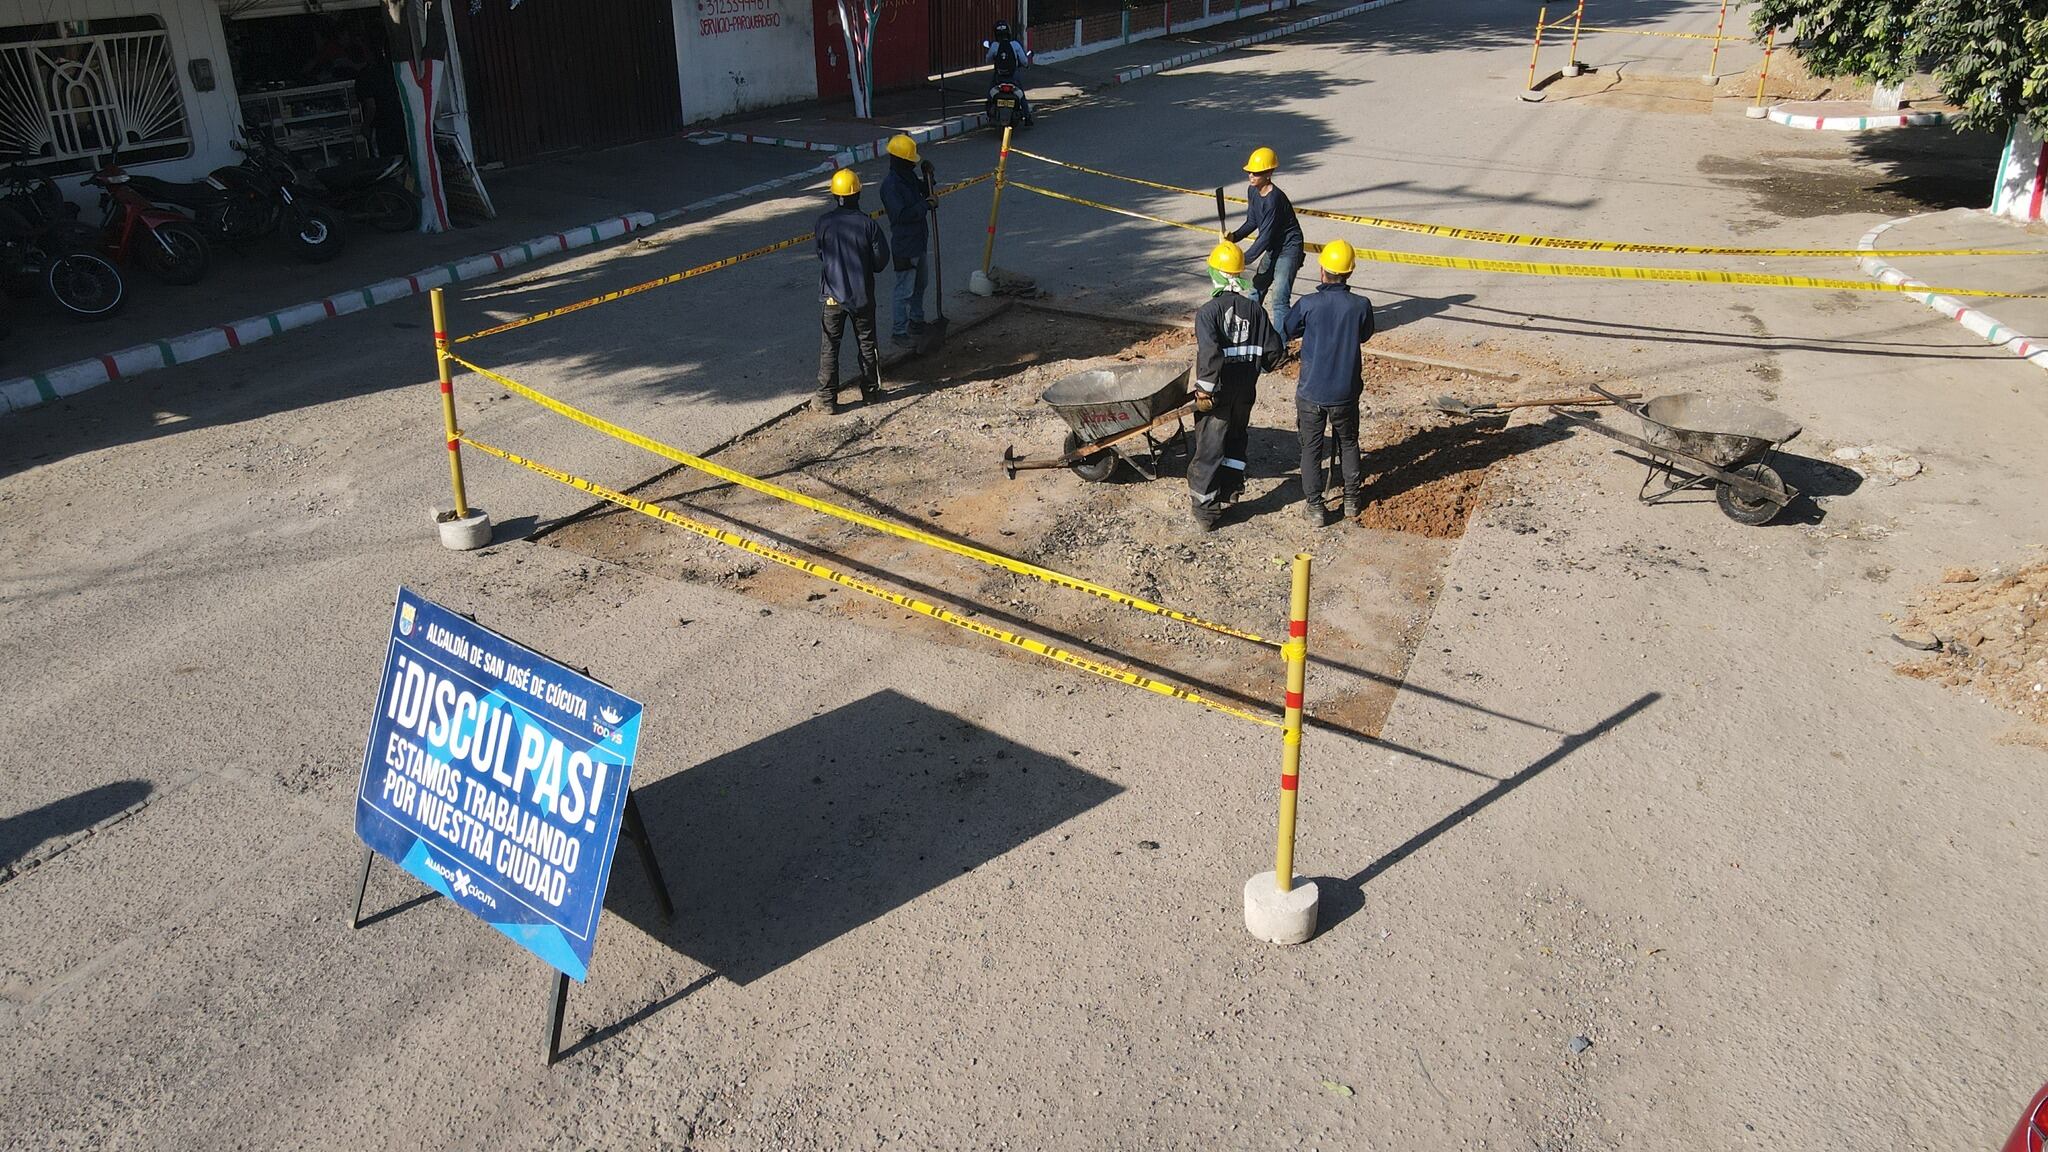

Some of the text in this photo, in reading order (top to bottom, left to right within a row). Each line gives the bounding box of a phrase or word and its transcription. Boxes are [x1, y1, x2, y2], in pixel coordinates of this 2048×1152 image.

[426, 622, 588, 720] ALCALDÍA DE SAN JOSÉ DE CÚCUTA
[385, 732, 581, 874] ESTAMOS TRABAJANDO
[388, 655, 608, 834] ¡DISCULPAS!
[383, 768, 567, 907] POR NUESTRA CIUDAD
[425, 857, 455, 882] ALIADOS
[468, 884, 497, 910] CÚCUTA
